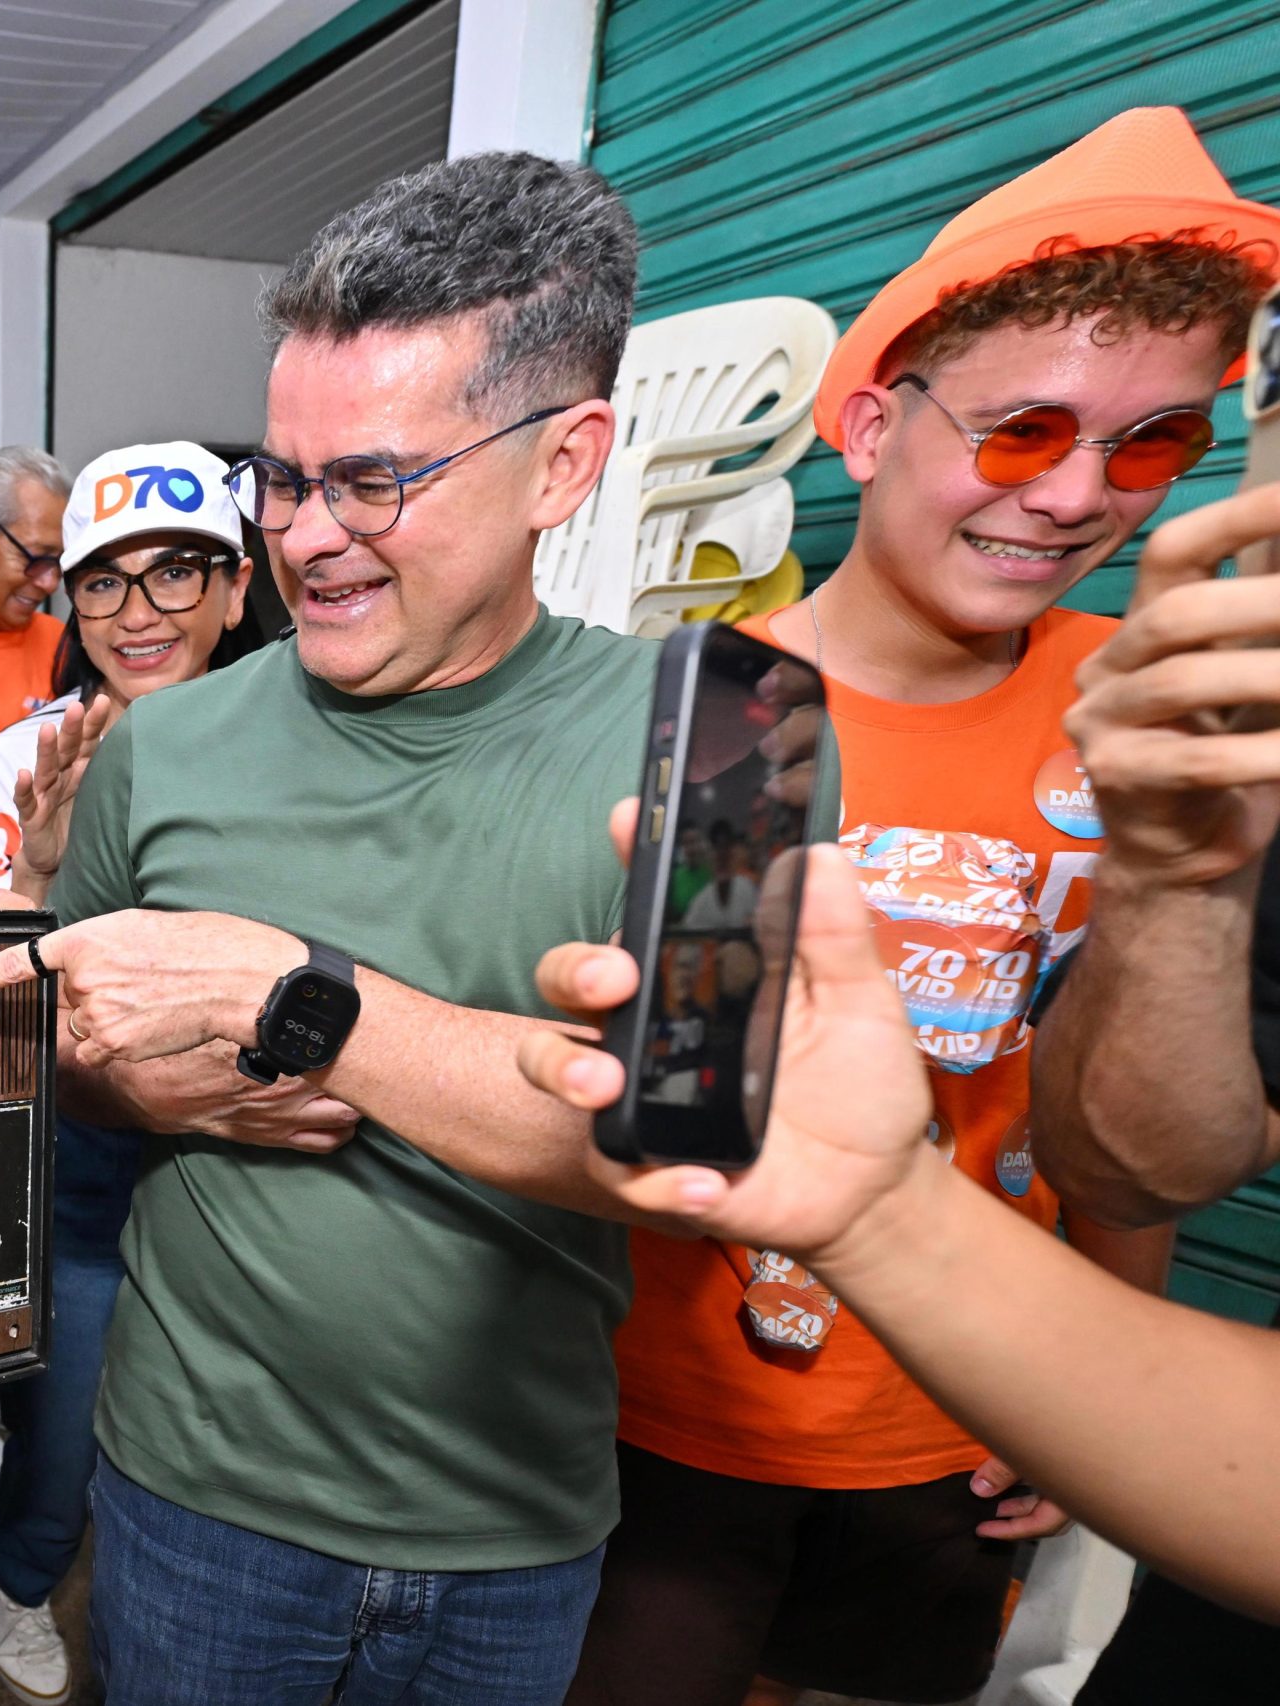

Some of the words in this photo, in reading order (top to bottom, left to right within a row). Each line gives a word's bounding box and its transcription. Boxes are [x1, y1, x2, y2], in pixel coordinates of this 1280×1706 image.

[94, 466, 204, 523] D70
[1049, 790, 1095, 807] DAV
[898, 941, 967, 980] 70
[975, 947, 1031, 980] 70
[885, 968, 956, 999] VID
[920, 1033, 982, 1056] VID
[778, 1299, 823, 1337] 70
